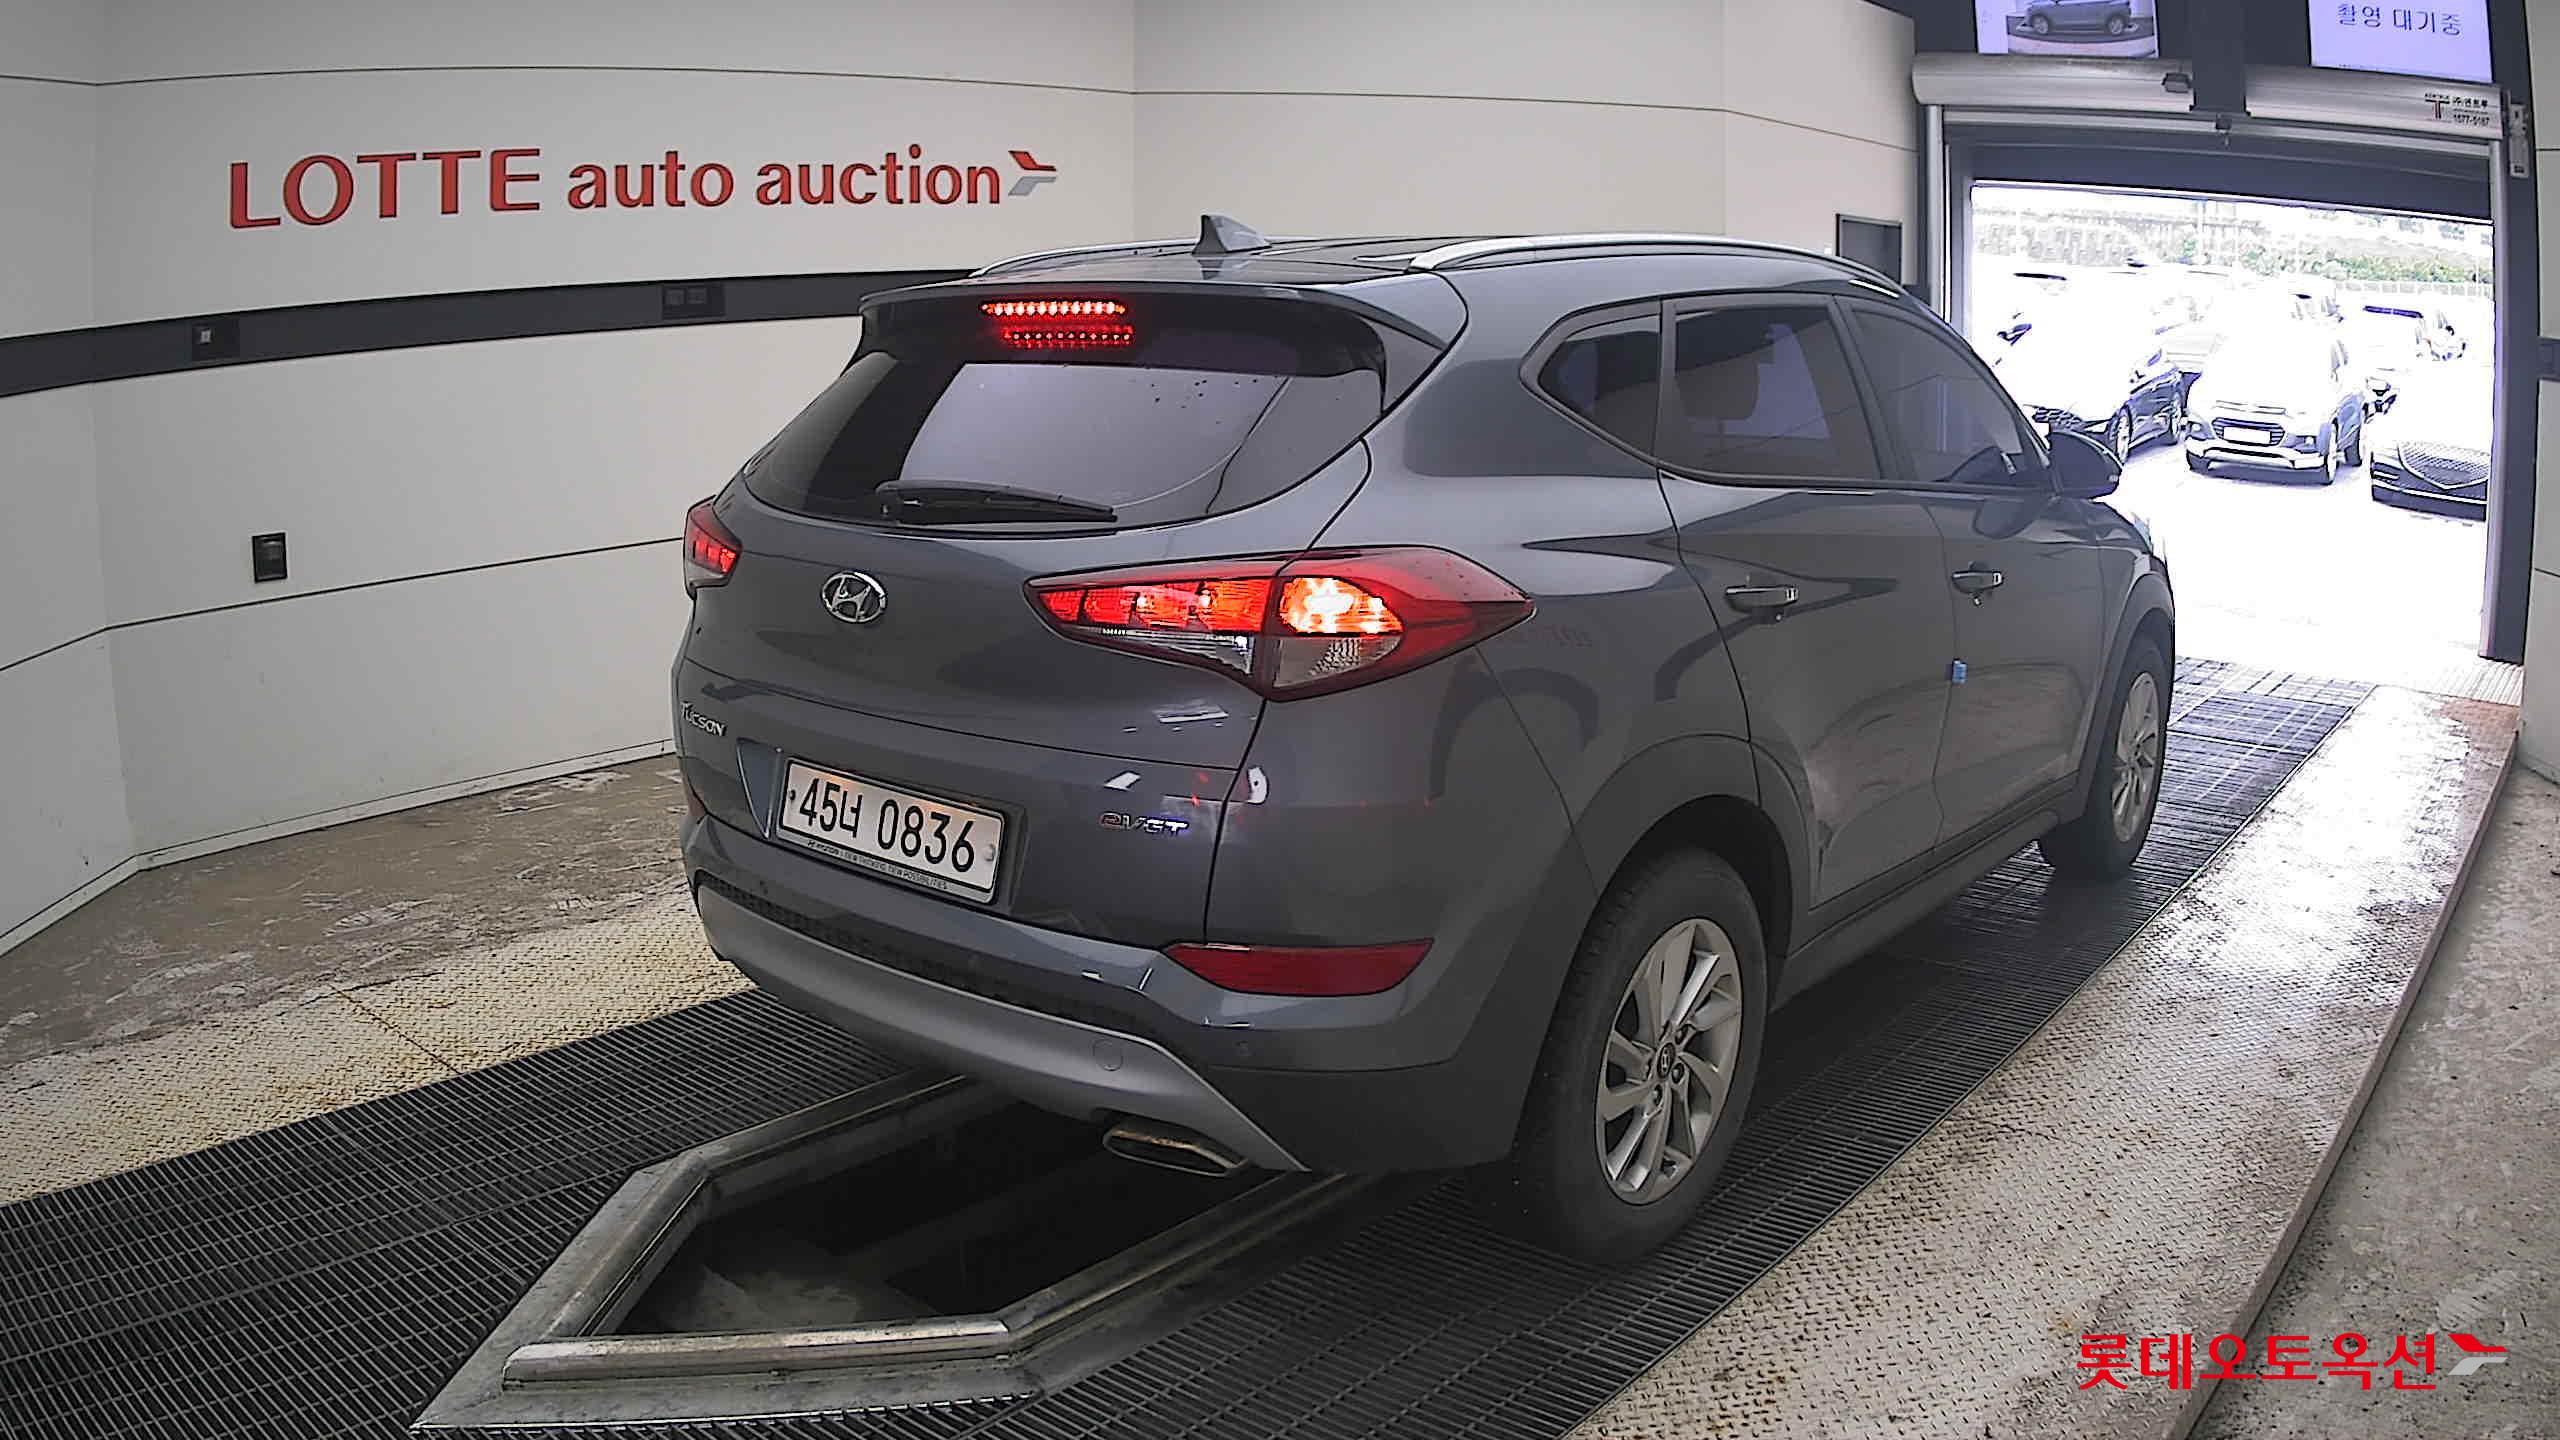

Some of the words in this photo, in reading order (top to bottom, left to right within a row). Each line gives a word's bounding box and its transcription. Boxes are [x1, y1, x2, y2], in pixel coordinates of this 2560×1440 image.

[2338, 4, 2381, 28] 촬영
[2393, 9, 2461, 36] 대기중
[230, 149, 541, 229] LOTTE
[568, 150, 735, 209] auto
[755, 144, 1001, 206] auction
[799, 778, 862, 839] 45너
[878, 799, 975, 873] 0836
